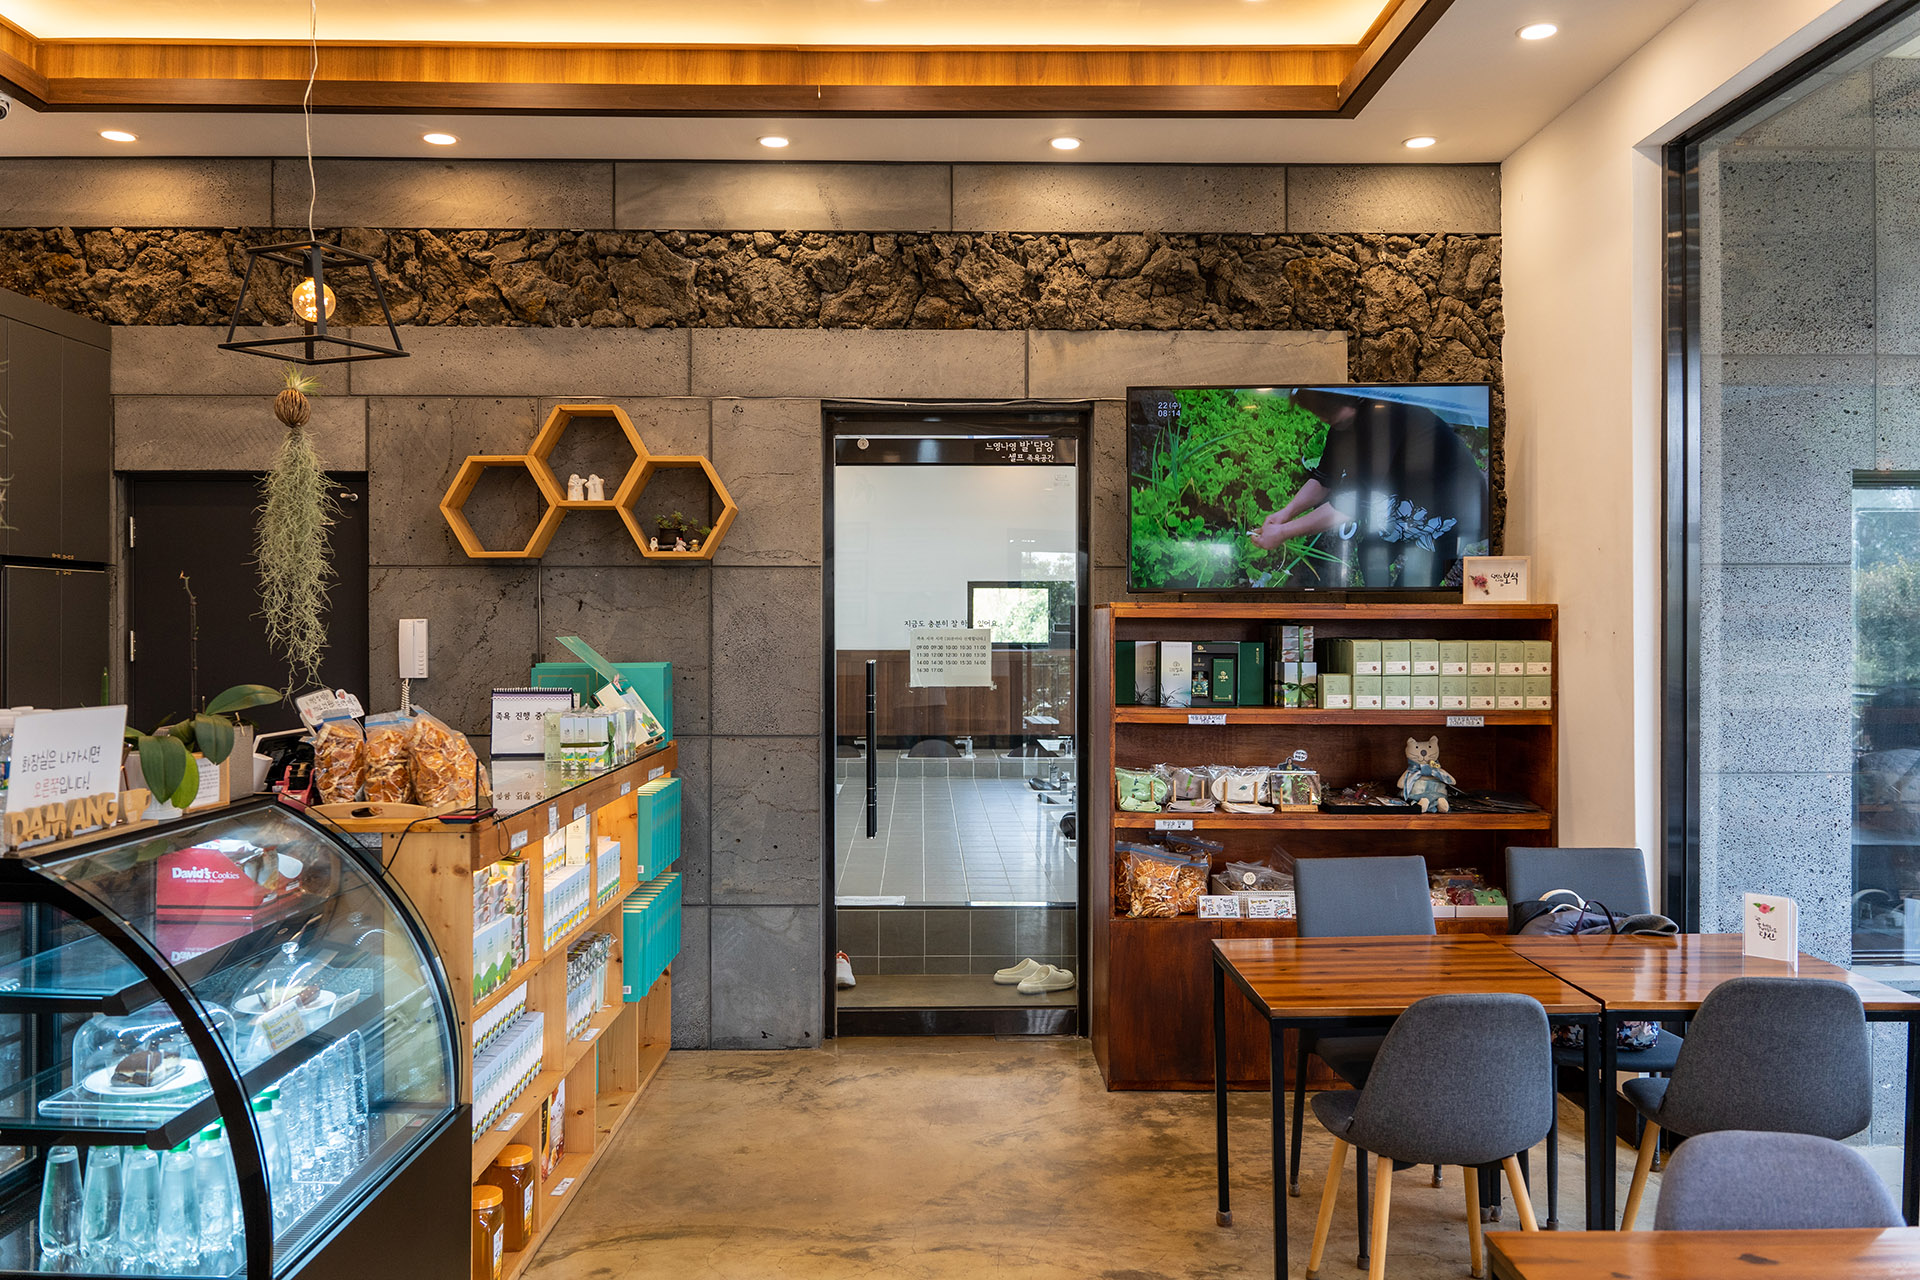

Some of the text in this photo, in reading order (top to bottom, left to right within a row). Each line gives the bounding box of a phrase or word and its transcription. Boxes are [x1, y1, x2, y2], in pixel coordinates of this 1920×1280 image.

[1157, 401, 1182, 410] 22(수)
[985, 440, 1055, 453] 느영나영 발'담앙
[1008, 453, 1055, 463] 셀프 족욕공간
[1503, 572, 1519, 585] 보석
[904, 620, 925, 629] 지금도
[928, 620, 949, 629] 충분히
[951, 620, 959, 628] 잘
[496, 711, 511, 721] 족욕
[515, 711, 531, 721] 진행
[22, 745, 101, 773] 화장실은 나가시면
[34, 771, 91, 799] 오른쪽입니다!
[172, 866, 240, 879] David's Cookies
